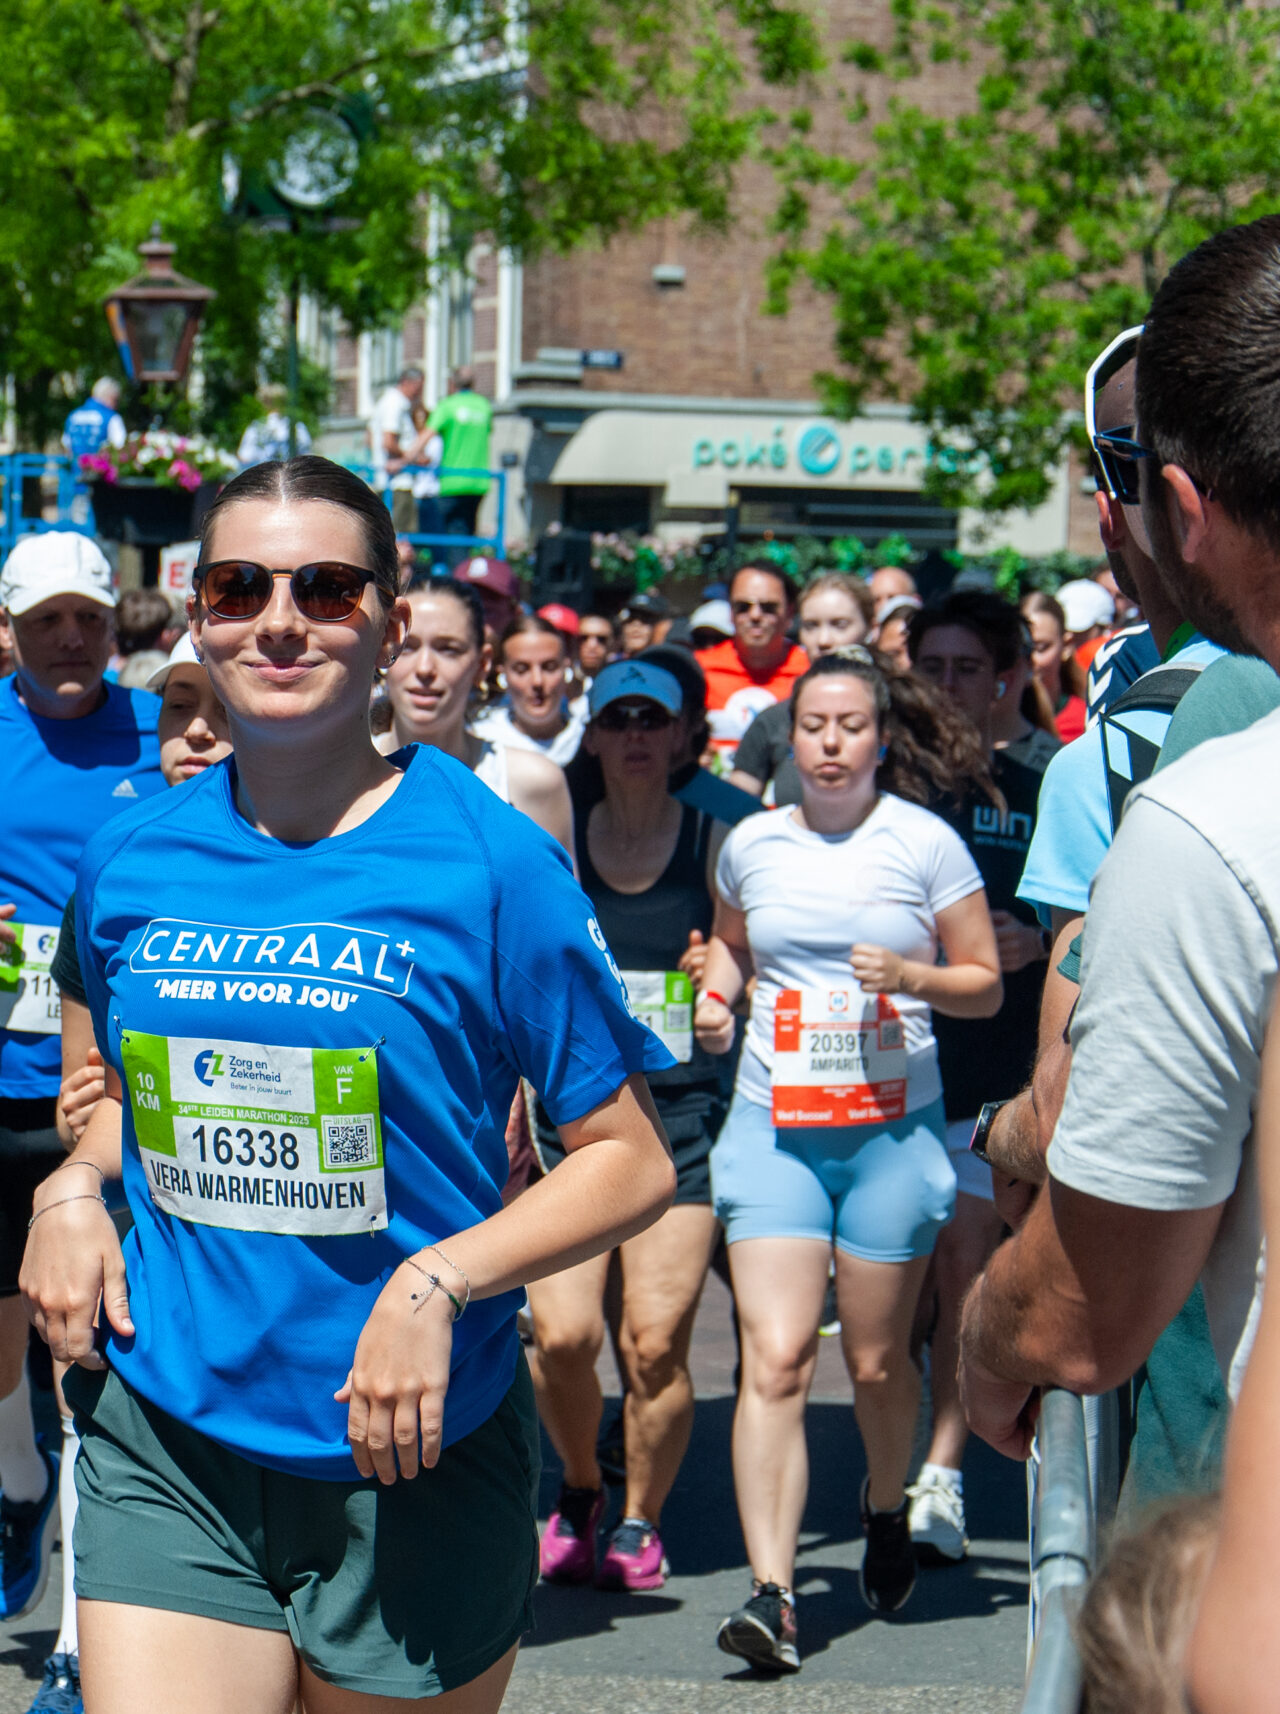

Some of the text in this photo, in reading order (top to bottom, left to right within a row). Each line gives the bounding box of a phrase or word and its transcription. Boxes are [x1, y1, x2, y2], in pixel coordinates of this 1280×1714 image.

[692, 421, 787, 469] poké
[223, 981, 291, 1004] VOOR
[810, 1033, 869, 1053] 20397
[229, 1055, 268, 1070] Zorg en
[333, 1065, 354, 1075] VAK
[136, 1071, 155, 1091] 10
[230, 1067, 281, 1083] Zekerheid
[135, 1090, 160, 1112] KM
[335, 1077, 353, 1105] F
[200, 1106, 234, 1119] LEIDEN
[236, 1108, 287, 1123] MARATHON
[288, 1114, 310, 1126] 2025
[192, 1124, 300, 1171] 16338
[150, 1159, 366, 1209] VERA WARMENHOVEN
